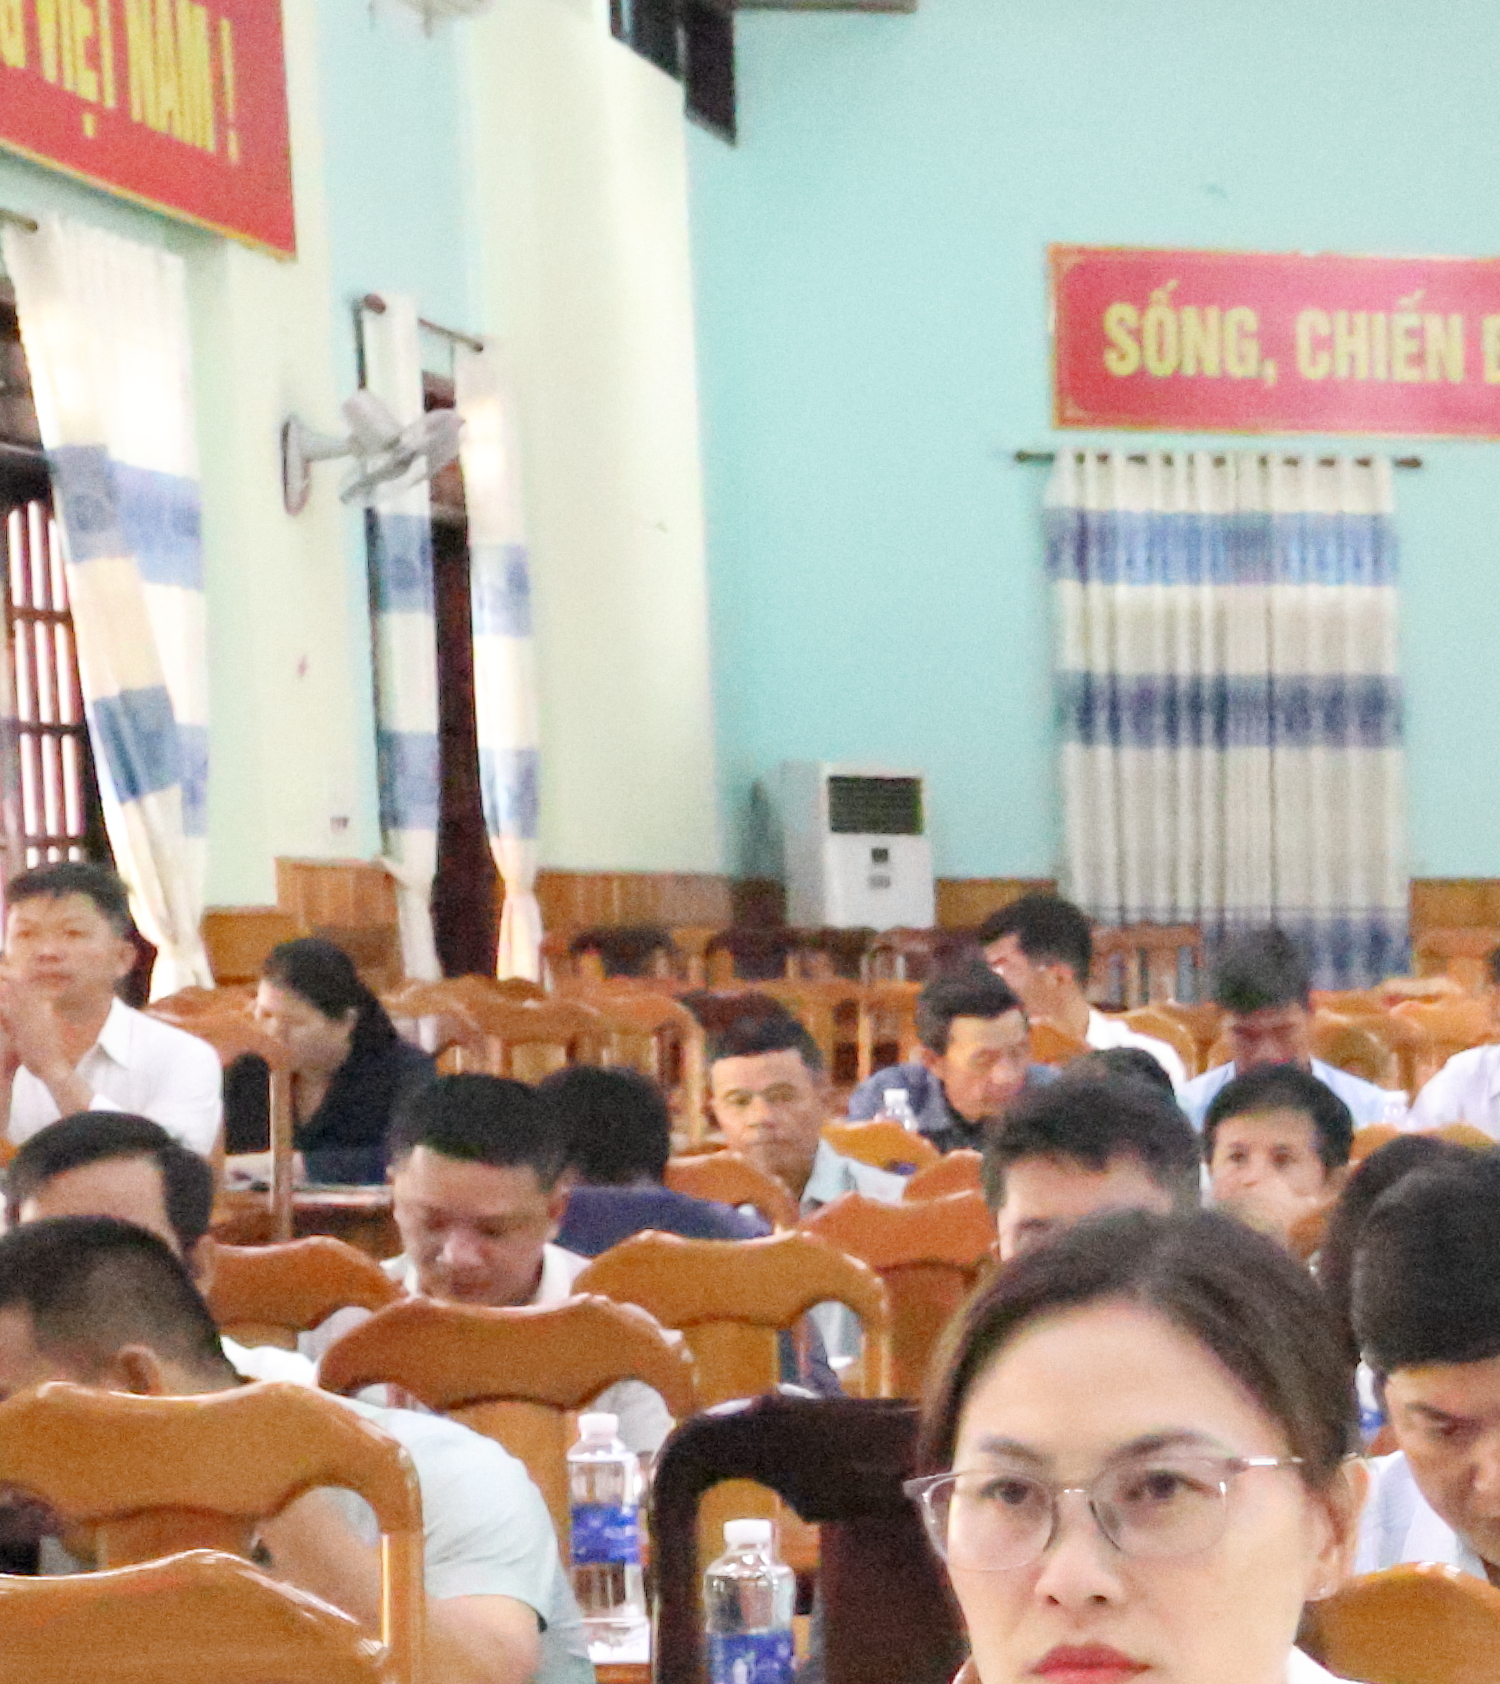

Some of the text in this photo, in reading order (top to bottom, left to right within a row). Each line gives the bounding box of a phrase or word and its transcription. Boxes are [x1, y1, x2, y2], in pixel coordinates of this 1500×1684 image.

[122, 0, 217, 154] NAM
[220, 17, 241, 165] !
[1104, 279, 1277, 389] SỐNG,
[1296, 289, 1465, 383] CHIẾN
